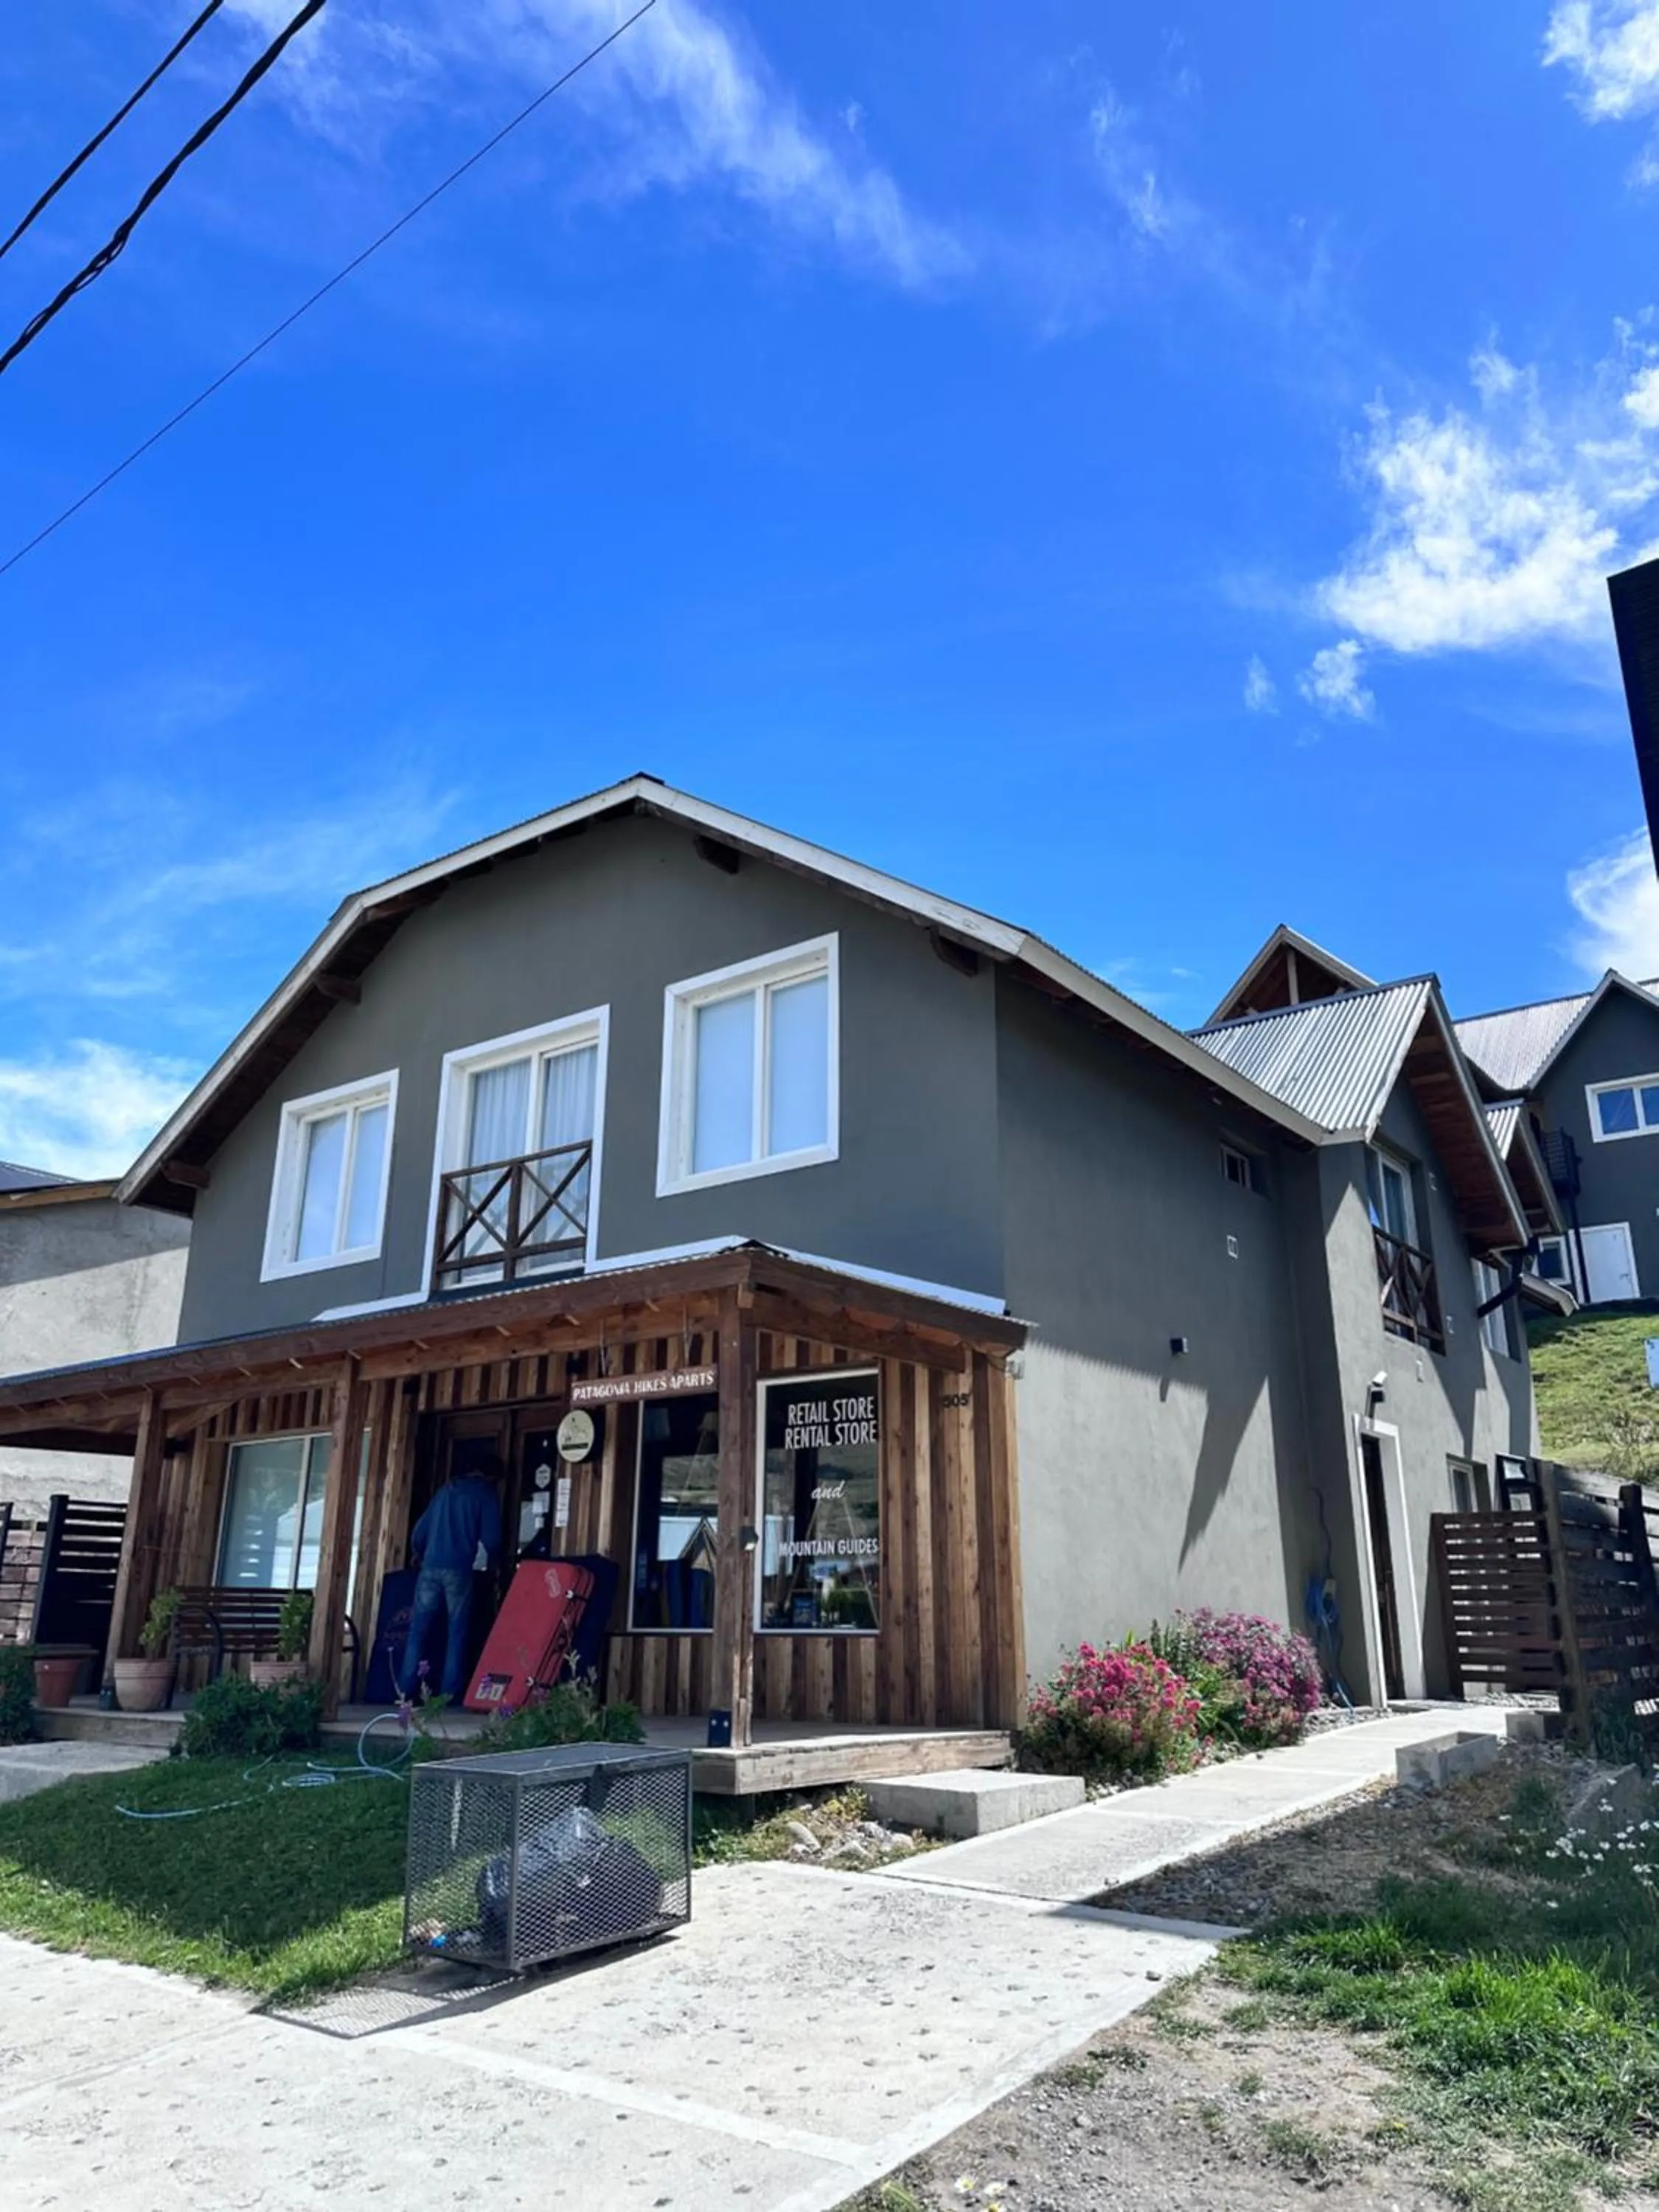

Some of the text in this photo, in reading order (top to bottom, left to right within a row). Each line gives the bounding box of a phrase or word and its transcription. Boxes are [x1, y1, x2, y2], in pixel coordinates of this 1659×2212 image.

[634, 1377, 667, 1394] HIKES
[669, 1371, 714, 1389] APARTS
[787, 1397, 874, 1426] RETAIL STORE
[785, 1421, 877, 1450] RENTAL STORE
[811, 1481, 846, 1500] and
[779, 1538, 878, 1557] MOUNTAIN GUIDES
